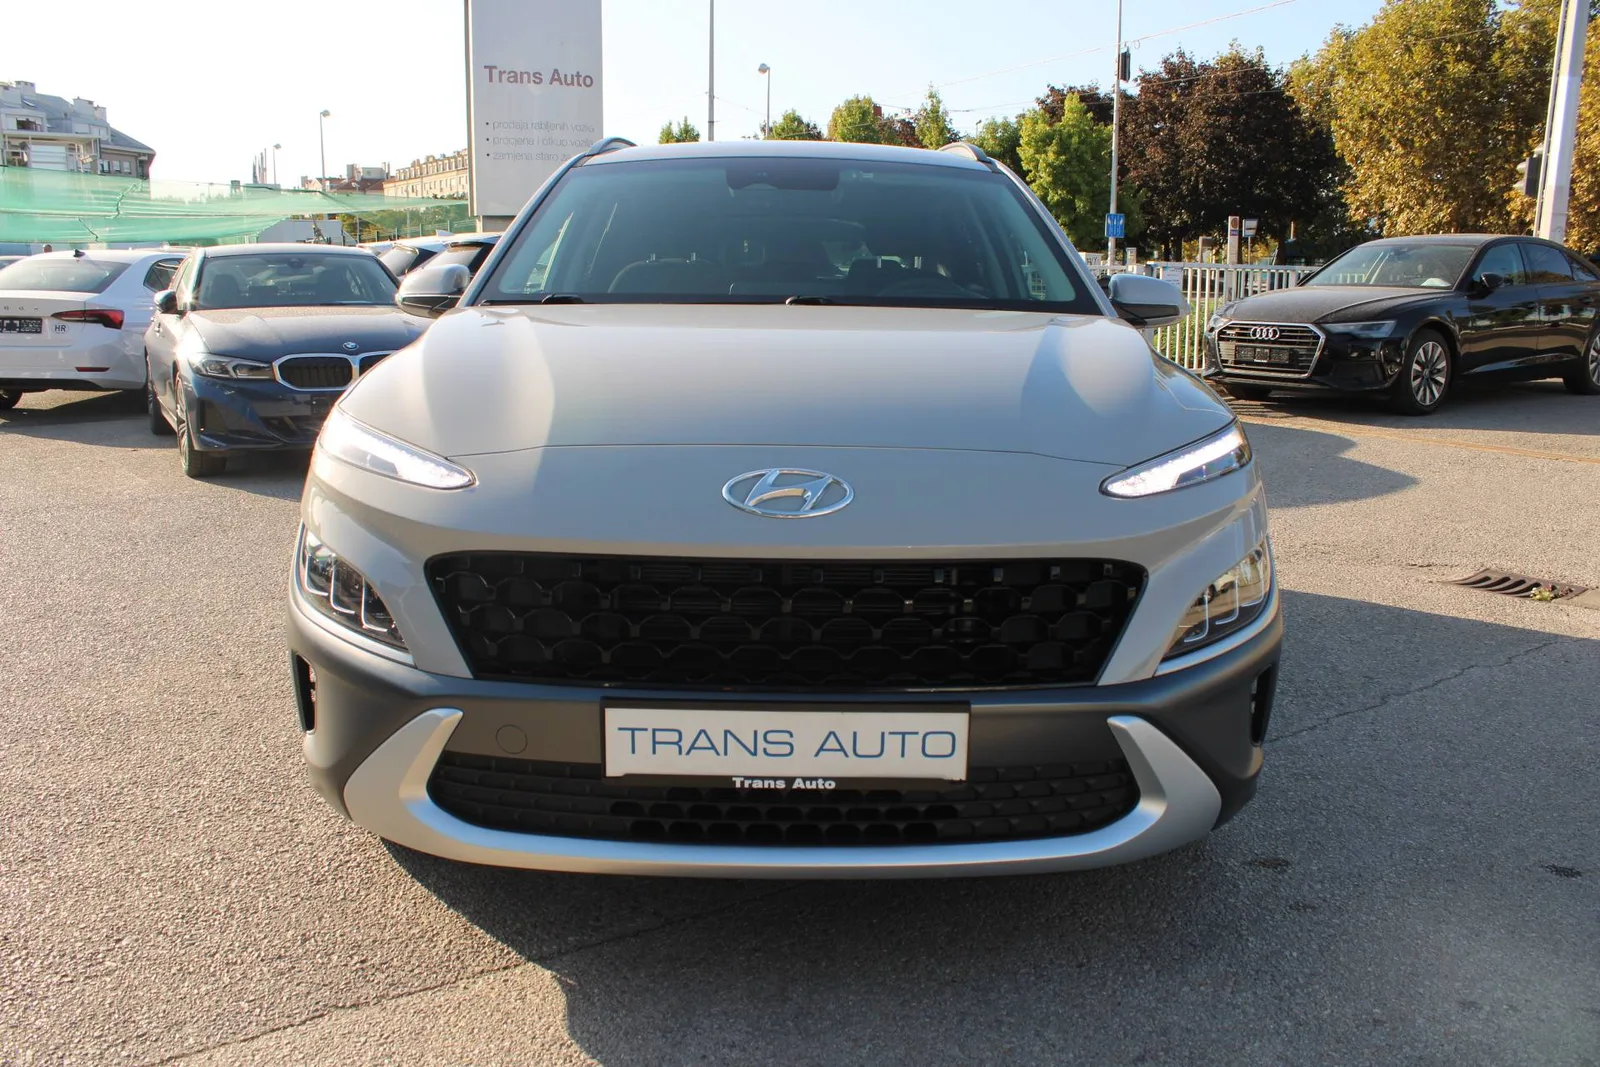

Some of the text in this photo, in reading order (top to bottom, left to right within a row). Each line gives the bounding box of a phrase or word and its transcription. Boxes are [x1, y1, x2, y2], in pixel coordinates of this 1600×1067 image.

[483, 65, 594, 88] Trans Auto
[492, 120, 595, 133] prodaja rabljenih vozila
[492, 136, 535, 147] procjena
[542, 137, 568, 148] otkup
[492, 151, 533, 162] zamjena
[535, 151, 559, 162] staro
[54, 324, 66, 332] HR
[617, 726, 956, 759] TRANS AUTO
[732, 776, 836, 791] Trans Auto
